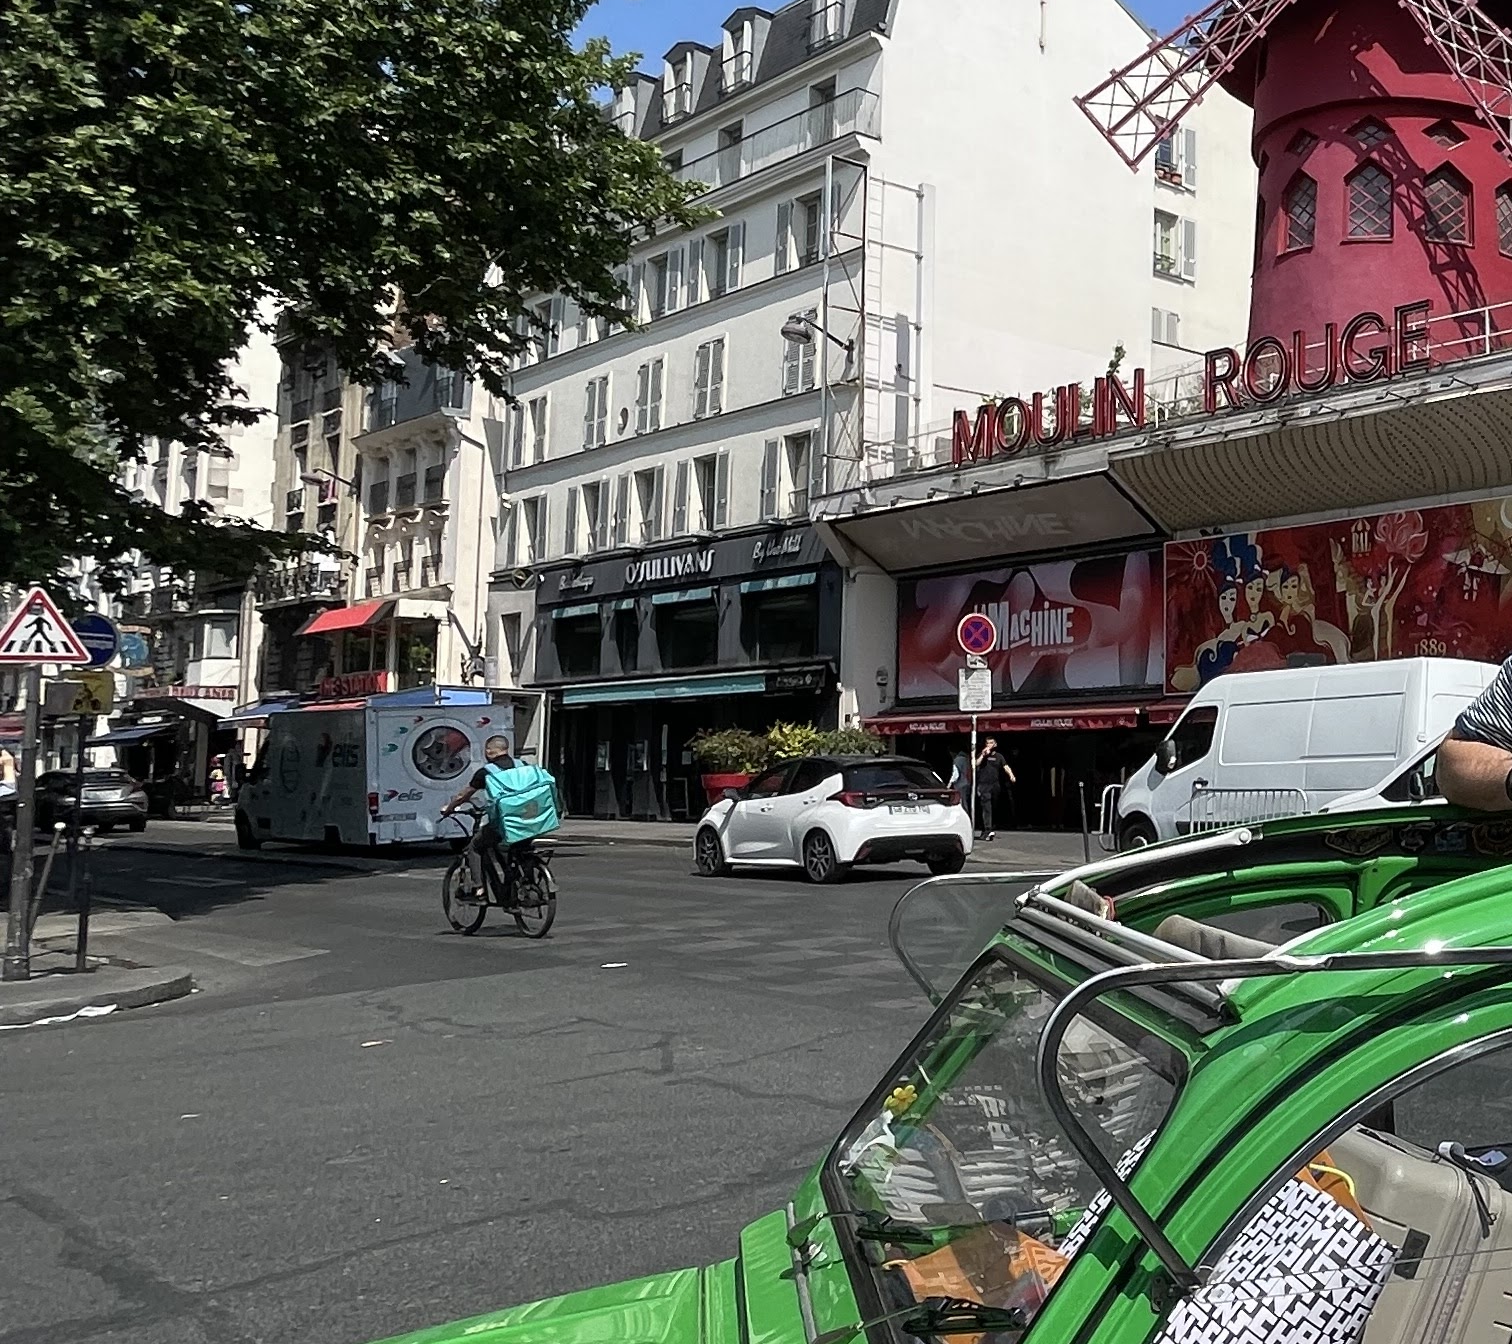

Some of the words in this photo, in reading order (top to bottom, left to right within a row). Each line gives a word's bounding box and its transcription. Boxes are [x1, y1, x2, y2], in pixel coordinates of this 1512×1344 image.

[951, 367, 1146, 469] MOULIN
[1204, 298, 1434, 415] ROUGE
[1414, 638, 1448, 657] 1889
